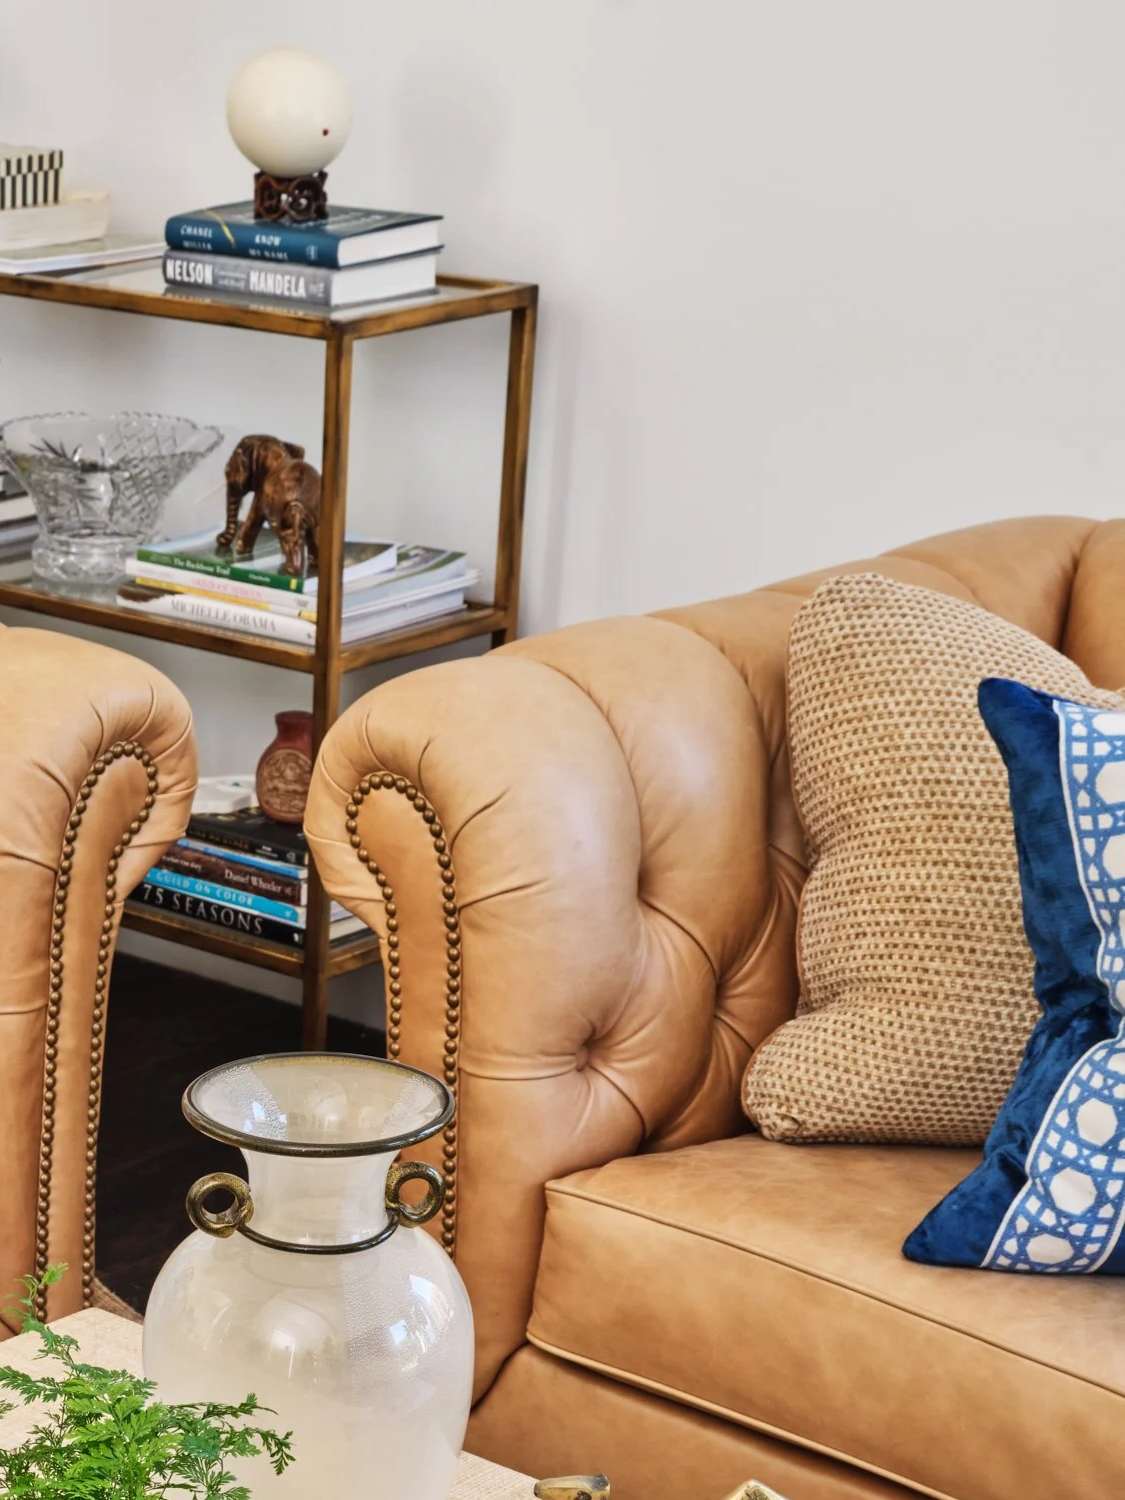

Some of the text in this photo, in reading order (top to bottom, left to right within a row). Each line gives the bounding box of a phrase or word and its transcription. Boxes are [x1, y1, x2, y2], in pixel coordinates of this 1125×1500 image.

[255, 234, 282, 247] KNOW
[165, 258, 213, 285] NELSON
[249, 270, 307, 299] MANDELA
[171, 598, 276, 631] MICHELLE OBAMA
[224, 868, 282, 894] Daniel Wheeler
[143, 883, 262, 934] 75 SEASONS
[216, 887, 254, 906] COLOR
